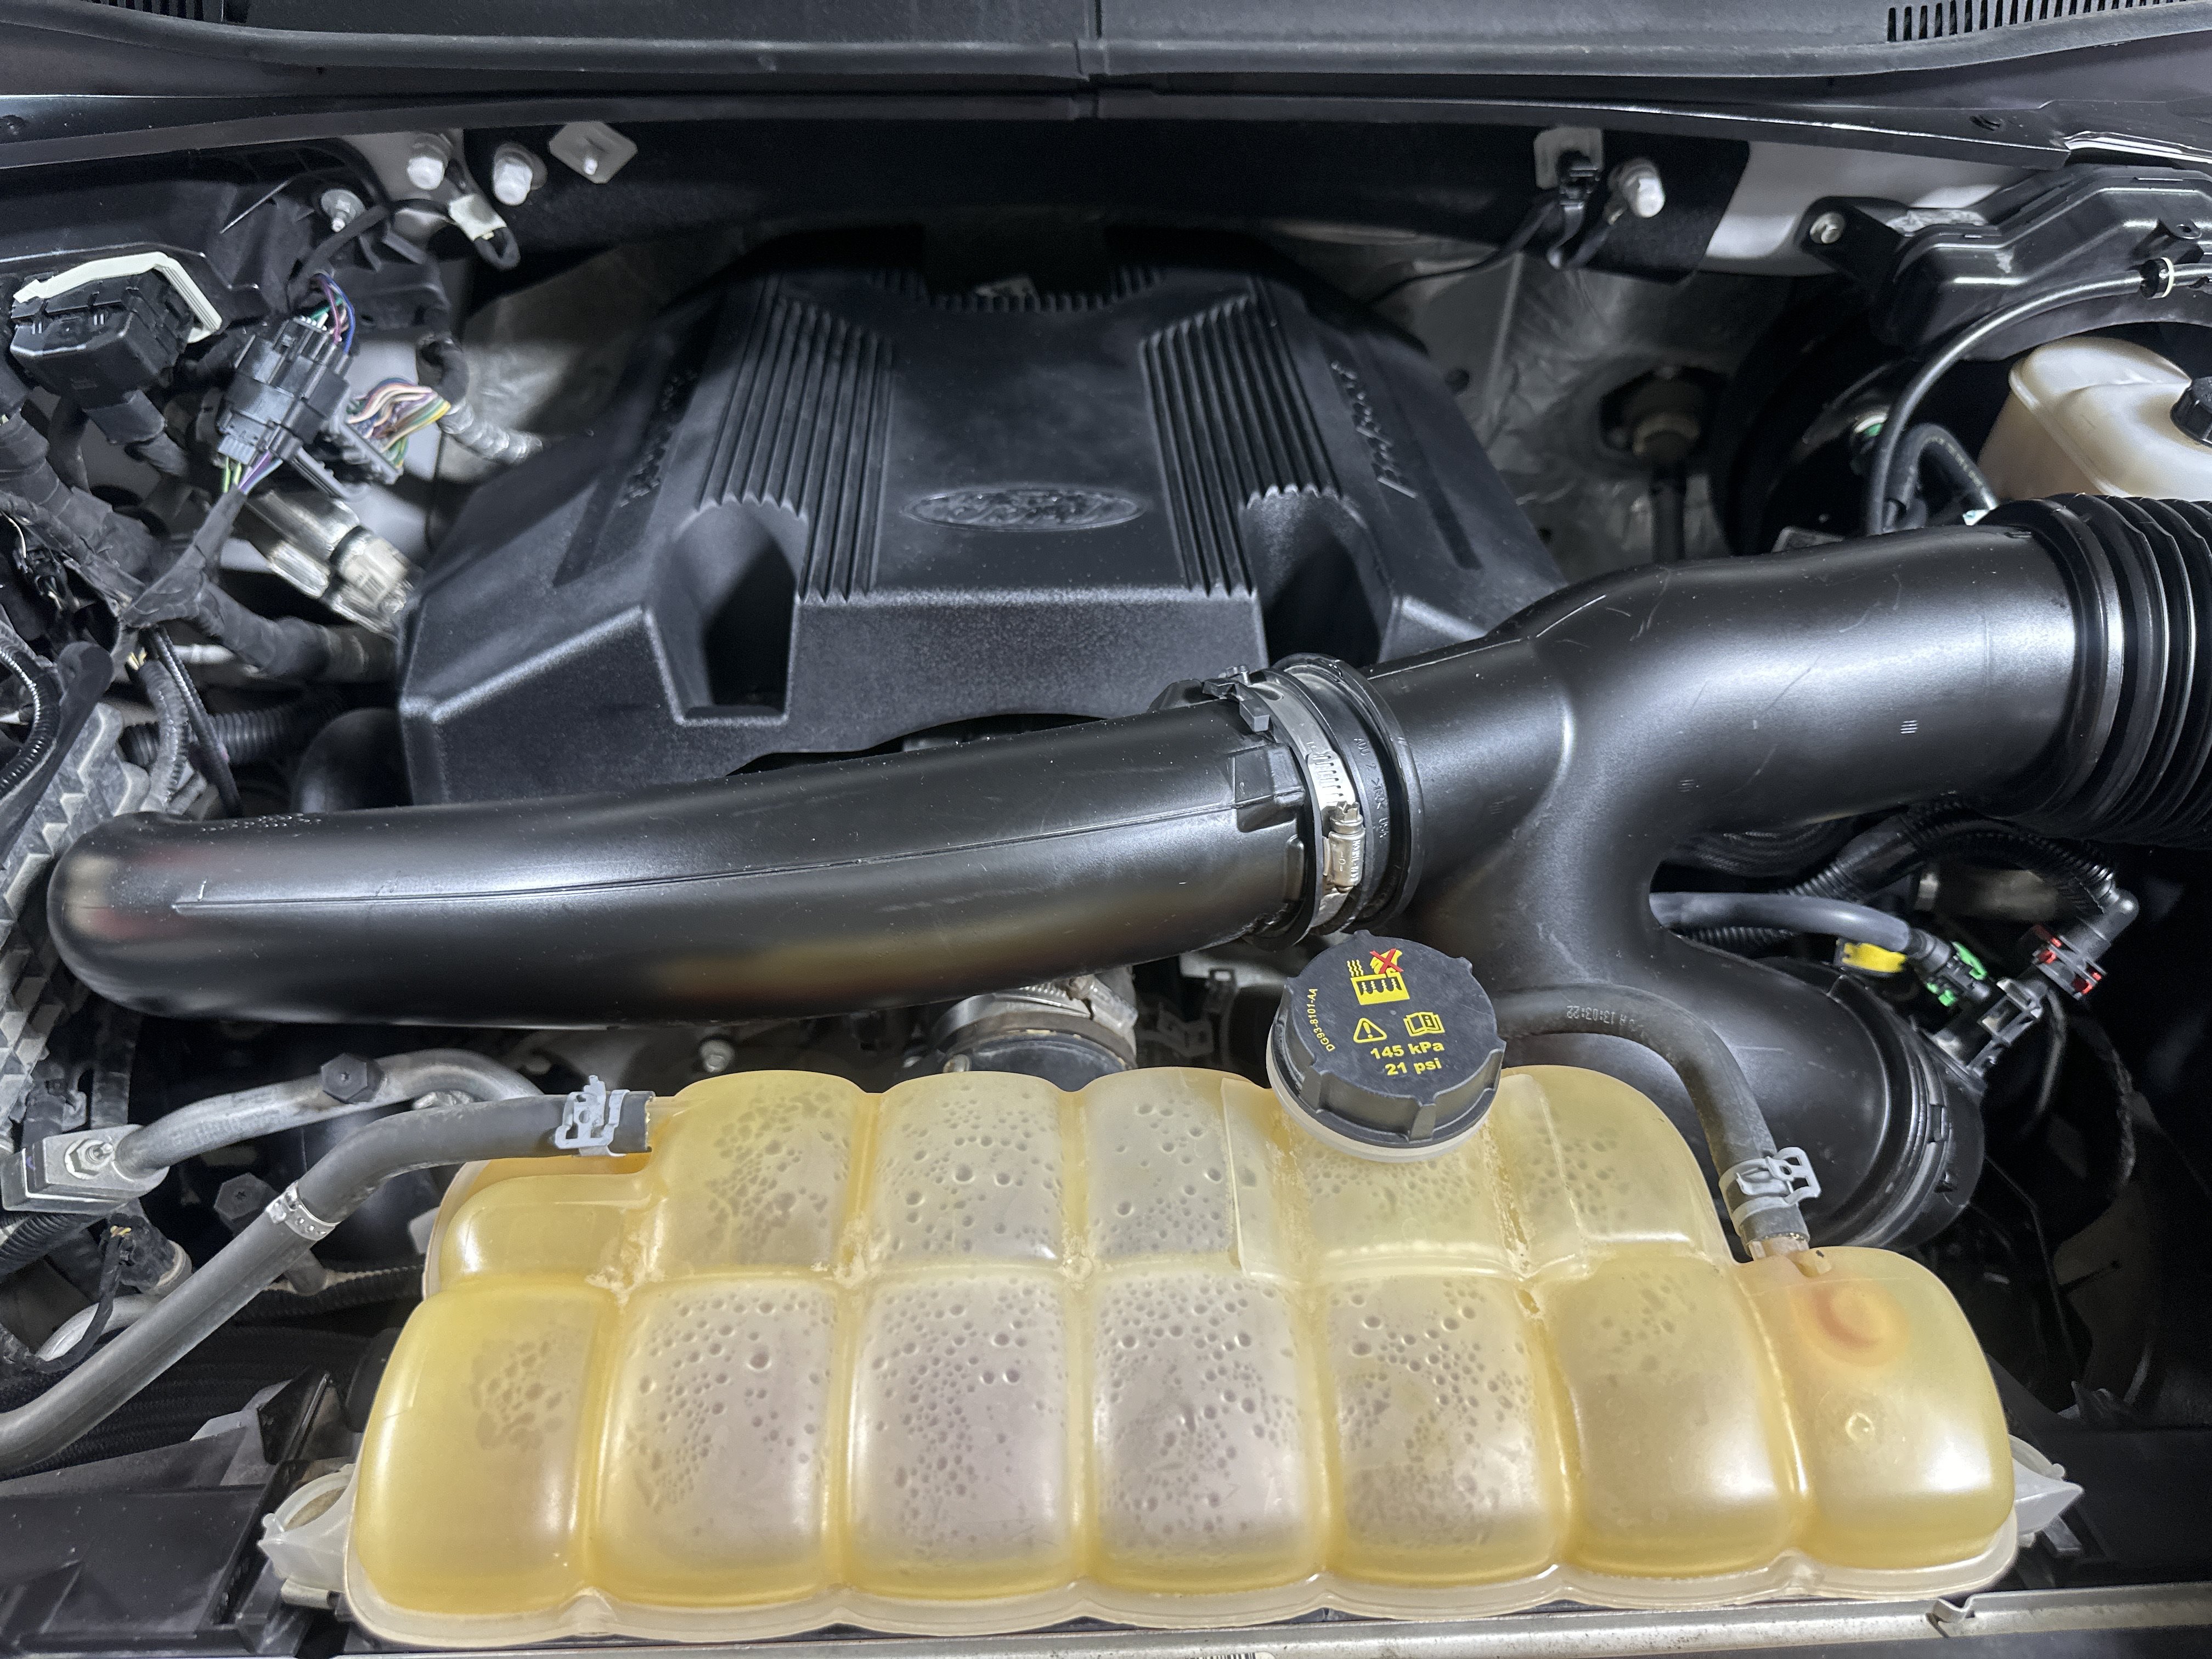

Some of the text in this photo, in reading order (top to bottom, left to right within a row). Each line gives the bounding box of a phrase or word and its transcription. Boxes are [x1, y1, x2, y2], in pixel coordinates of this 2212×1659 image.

[1306, 988, 1335, 1052] DG93-8101-AA
[1566, 1005, 1615, 1025] 13:03:22
[1370, 1041, 1444, 1059] 145 kPa
[1385, 1058, 1443, 1075] 21 psi
